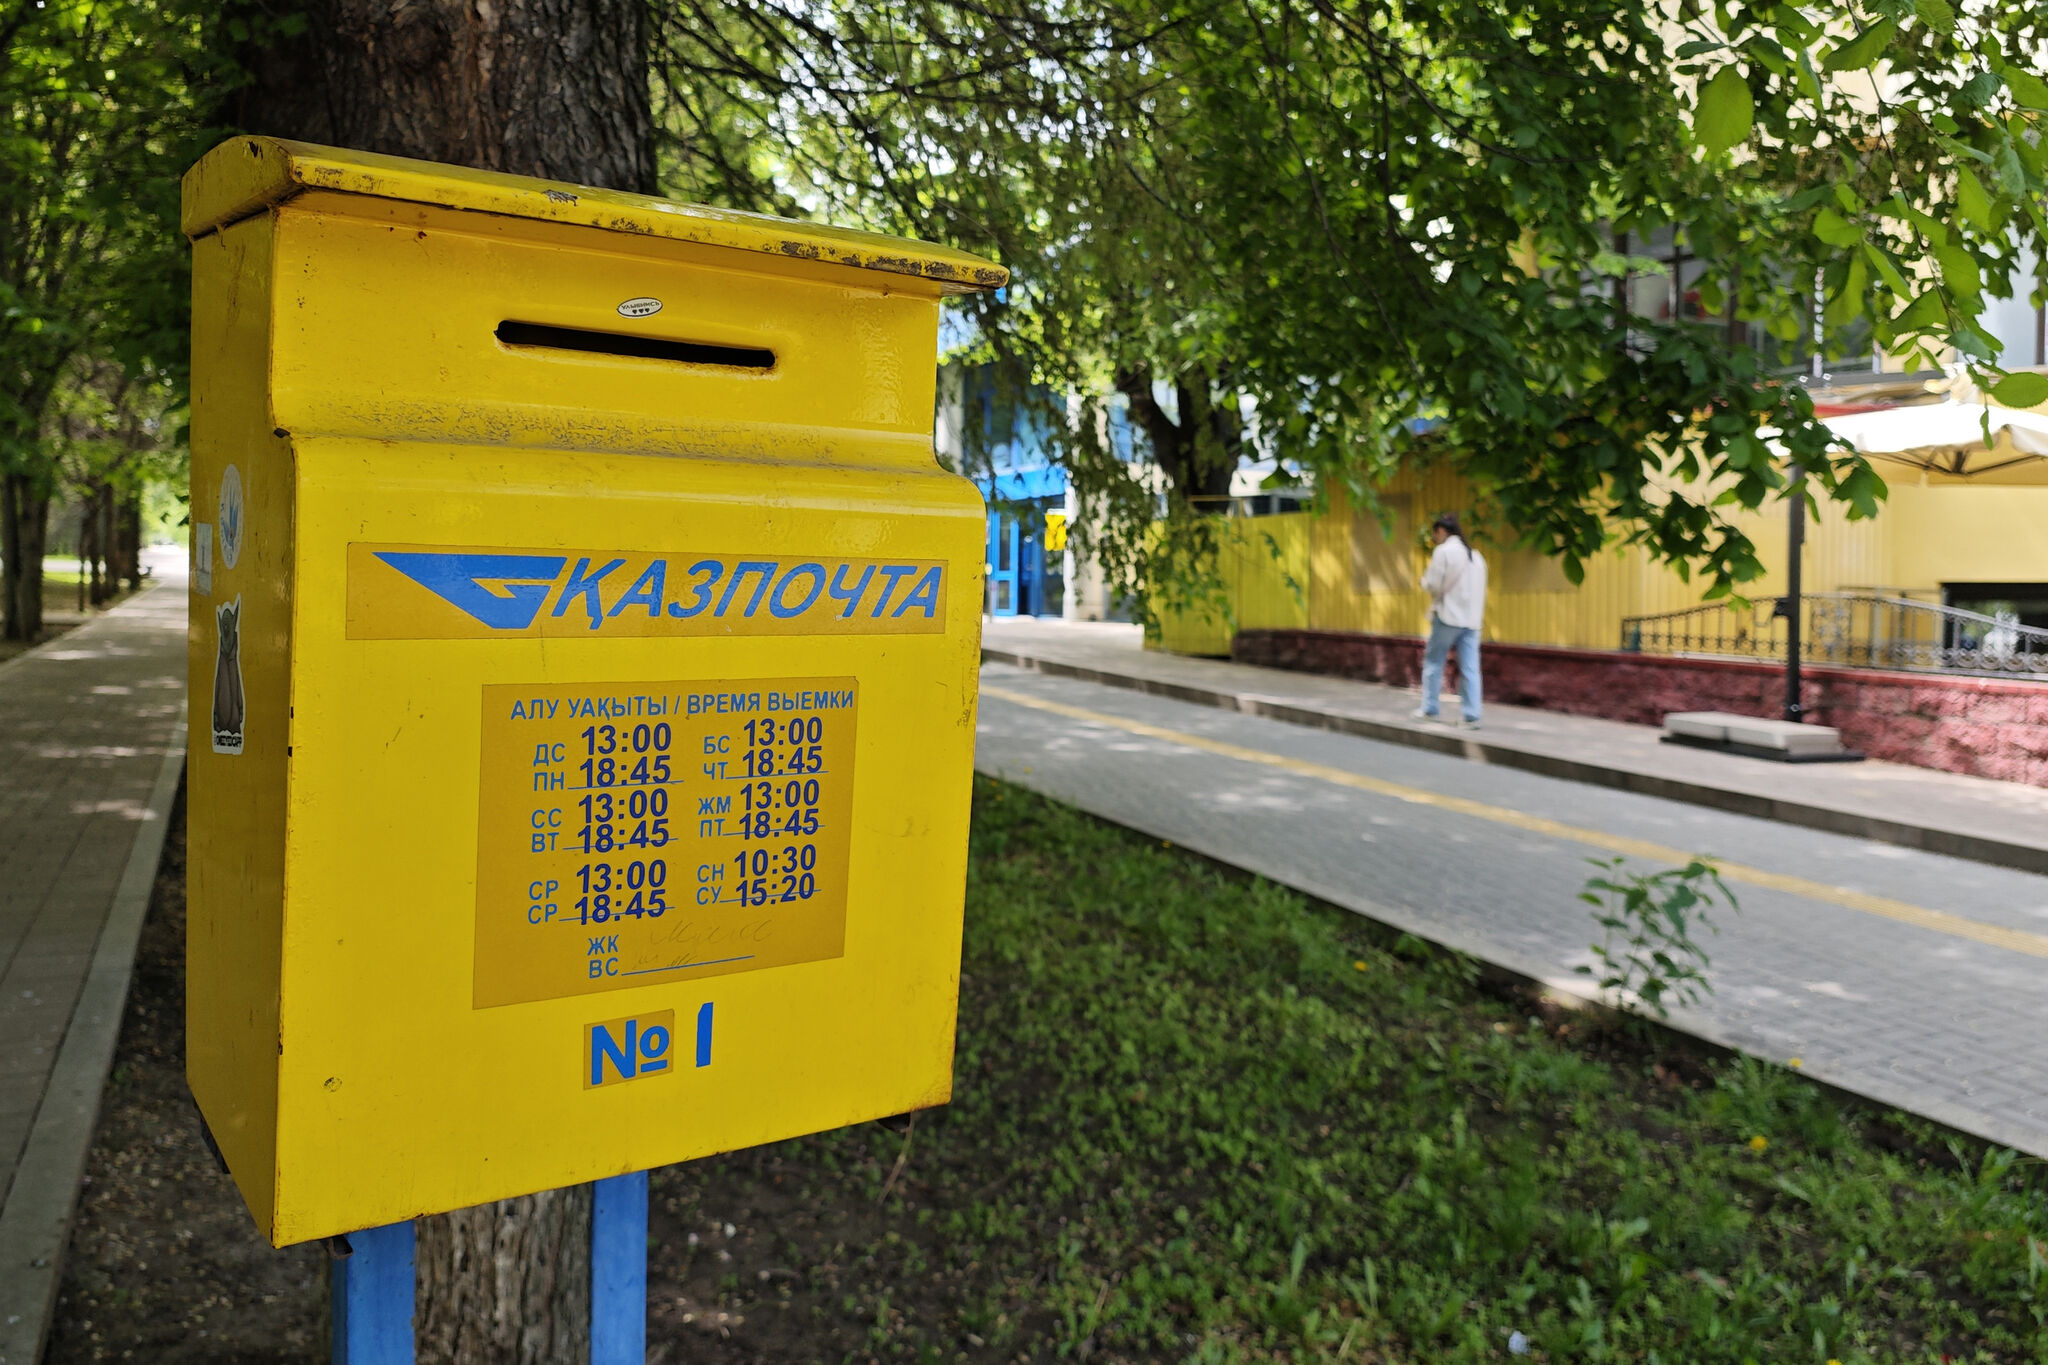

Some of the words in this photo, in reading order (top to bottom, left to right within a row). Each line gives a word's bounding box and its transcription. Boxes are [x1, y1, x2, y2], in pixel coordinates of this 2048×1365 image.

[551, 557, 943, 630] ҚАЗПОЧТА
[510, 699, 559, 720] АЛУ
[568, 695, 667, 721] УАҚЫТЫ
[687, 693, 760, 715] ВРЕМЯ
[768, 691, 854, 711] ВЫЕМКИ
[533, 743, 566, 766] ДС
[581, 722, 671, 756] 13:00
[703, 735, 730, 754] БС
[743, 716, 823, 747] 13:00
[533, 772, 565, 792] ПН
[579, 755, 671, 788] 18:45
[703, 761, 726, 780] ЧТ
[742, 746, 822, 777] 18:45
[531, 808, 562, 828] СС
[578, 788, 669, 823] 13:00
[698, 796, 731, 816] ЖМ
[740, 779, 820, 811] 13:00
[531, 833, 559, 853] ВТ
[577, 819, 669, 854] 18:45
[700, 819, 724, 837] ПТ
[739, 809, 819, 840] 18:45
[529, 880, 558, 900] СР
[575, 859, 667, 894] 13:00
[697, 864, 724, 883] СН
[734, 844, 816, 878] 10:30
[527, 904, 558, 924] СР
[574, 889, 666, 925] 18:45
[696, 886, 722, 905] СУ
[735, 873, 814, 907] 15:20
[587, 934, 619, 956] ЖК
[589, 957, 619, 978] ВС
[696, 1002, 714, 1068] 1
